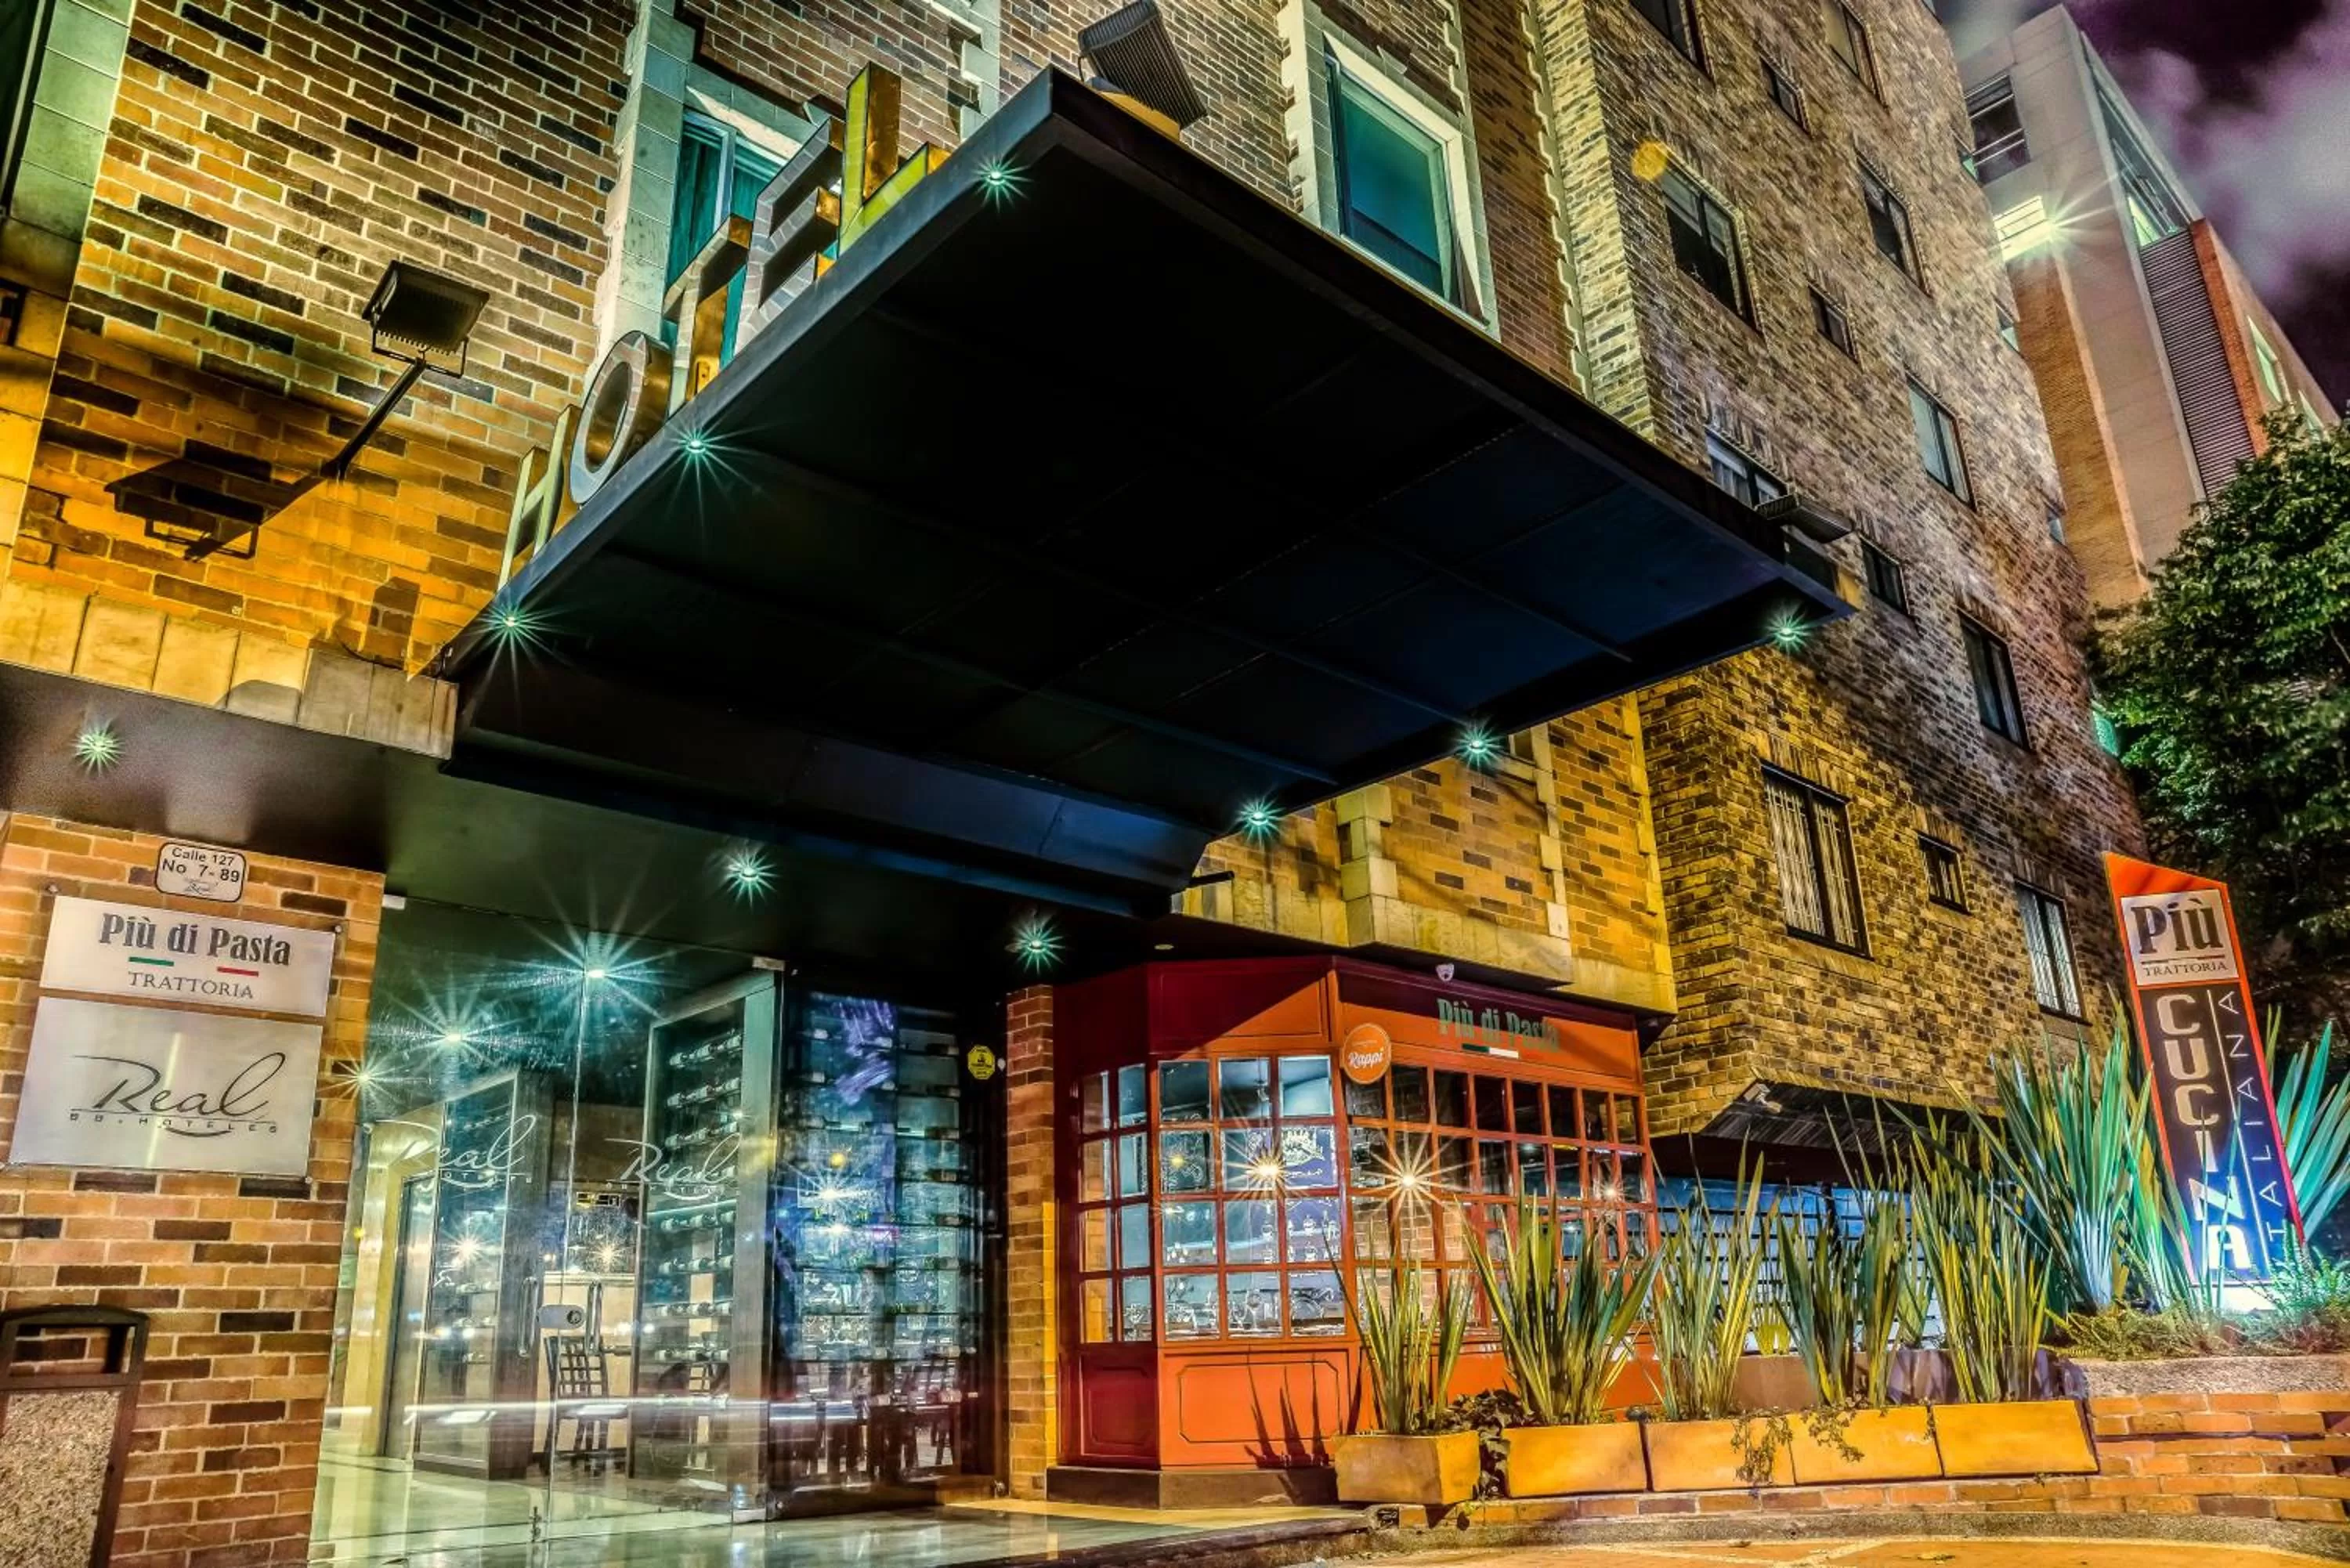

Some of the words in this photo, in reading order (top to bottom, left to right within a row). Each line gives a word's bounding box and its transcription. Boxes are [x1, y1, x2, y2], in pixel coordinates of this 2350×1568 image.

[497, 62, 949, 592] HOTEL
[161, 858, 187, 873] No
[172, 847, 206, 862] Calle
[213, 854, 235, 866] 127
[99, 912, 157, 950] Più
[167, 923, 198, 955] di
[206, 927, 291, 966] Pasta
[2130, 898, 2224, 954] Più
[128, 970, 254, 999] TRATTORIA
[2143, 962, 2229, 977] TRATTORIA
[1437, 997, 1474, 1039] Più
[1480, 1007, 1501, 1042] di
[1506, 1010, 1560, 1053] Pasta
[71, 1052, 286, 1116] Real
[1348, 1046, 1384, 1069] Rappi
[604, 1132, 741, 1184] Real
[2156, 993, 2251, 1270] CUCINA
